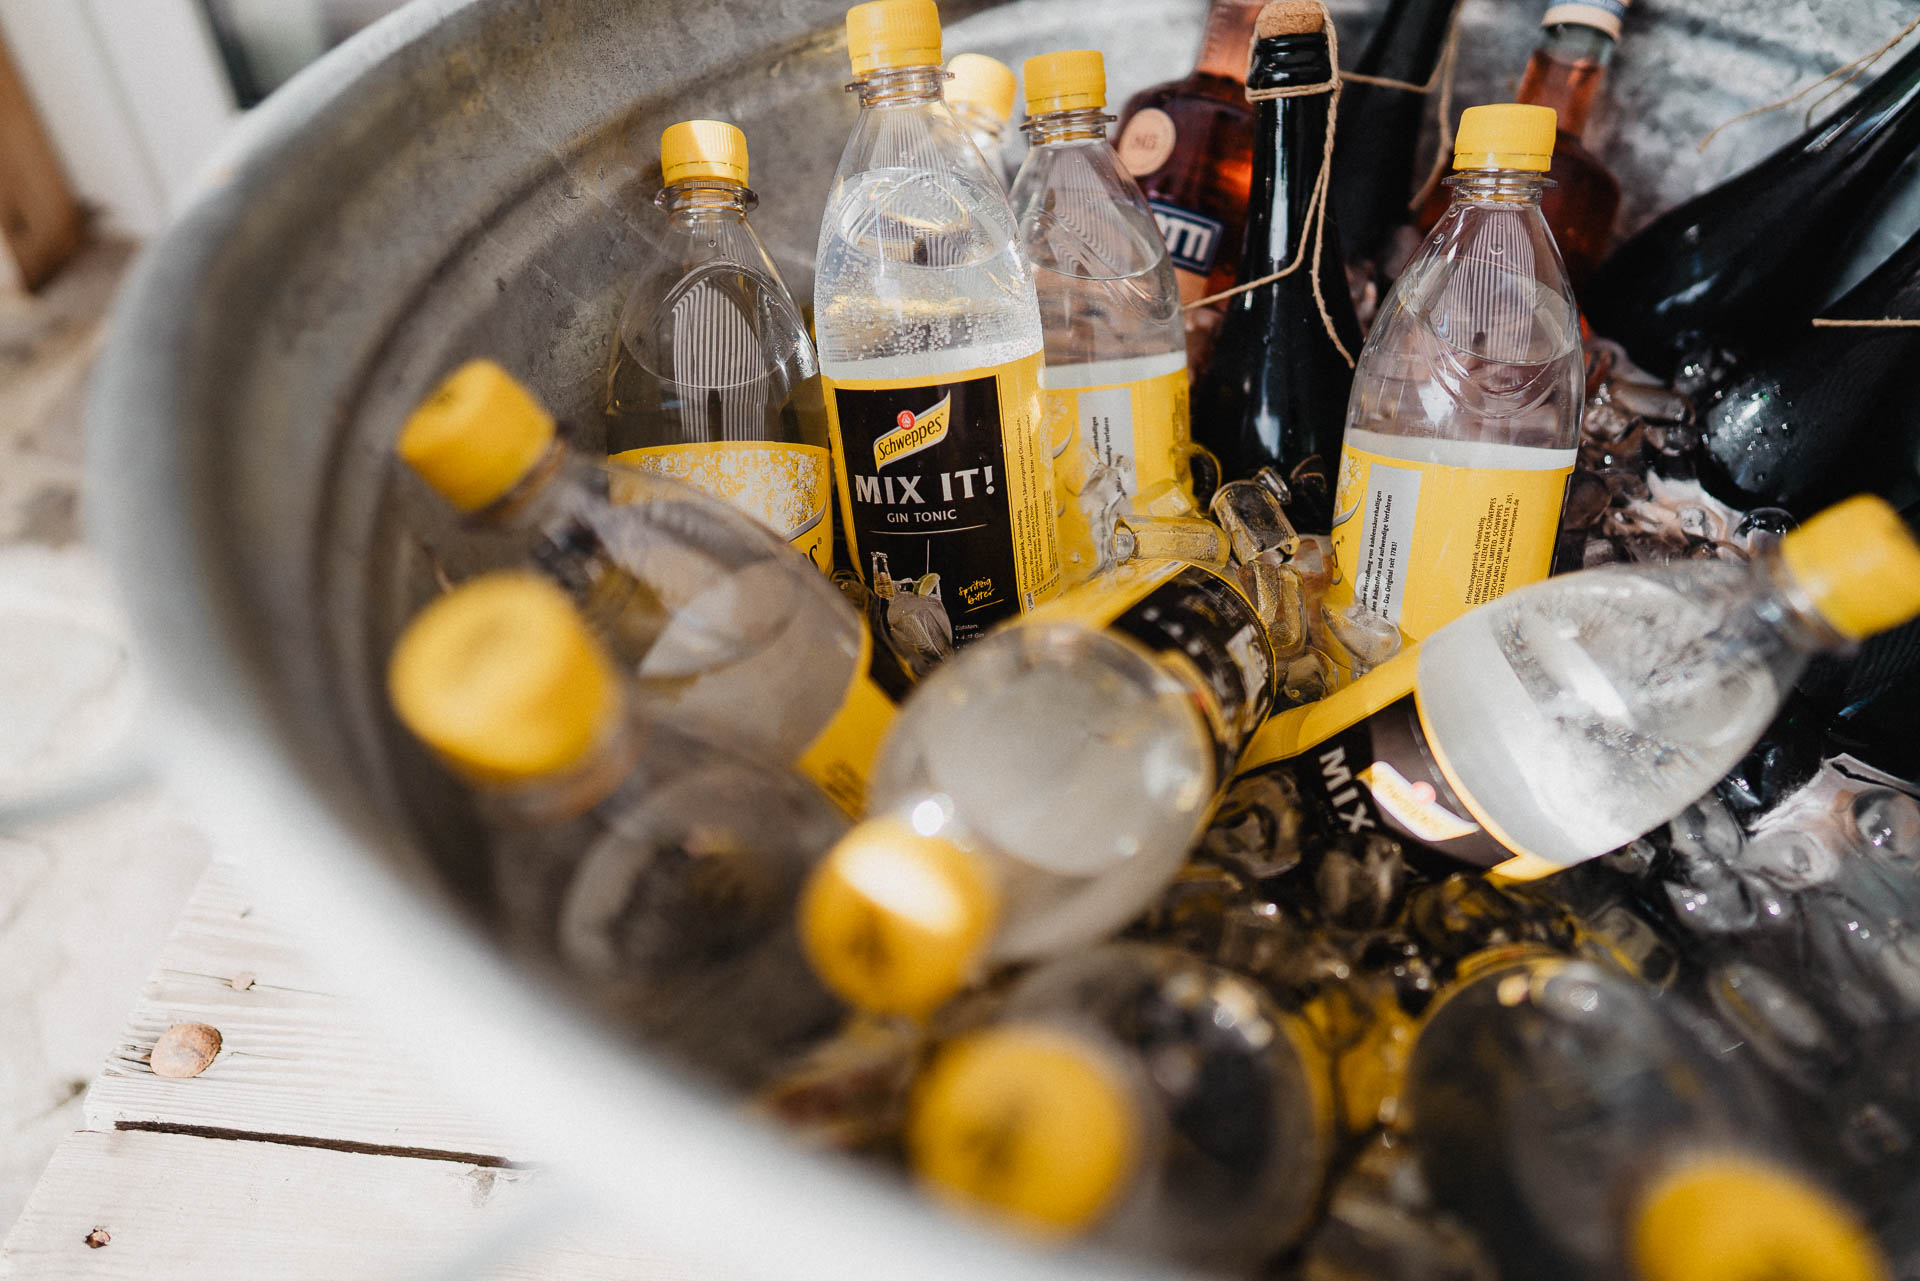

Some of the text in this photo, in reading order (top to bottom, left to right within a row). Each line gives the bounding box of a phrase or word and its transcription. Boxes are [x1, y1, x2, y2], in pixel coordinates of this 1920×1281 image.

[878, 416, 942, 461] Schweppes
[854, 465, 996, 505] MIX IT!
[886, 509, 957, 523] GIN TONIC
[1383, 494, 1393, 523] Verfahren
[1473, 570, 1485, 605] HERGESTELLT
[1481, 543, 1490, 562] LIZENZ
[1486, 497, 1497, 530] SCHWEPPES
[1499, 518, 1509, 545] HAGENER
[1481, 563, 1494, 604] NTERNATIONAL
[1493, 504, 1504, 537] SCHWEPPES
[1385, 569, 1394, 593] Original
[1319, 745, 1375, 833] MIX
